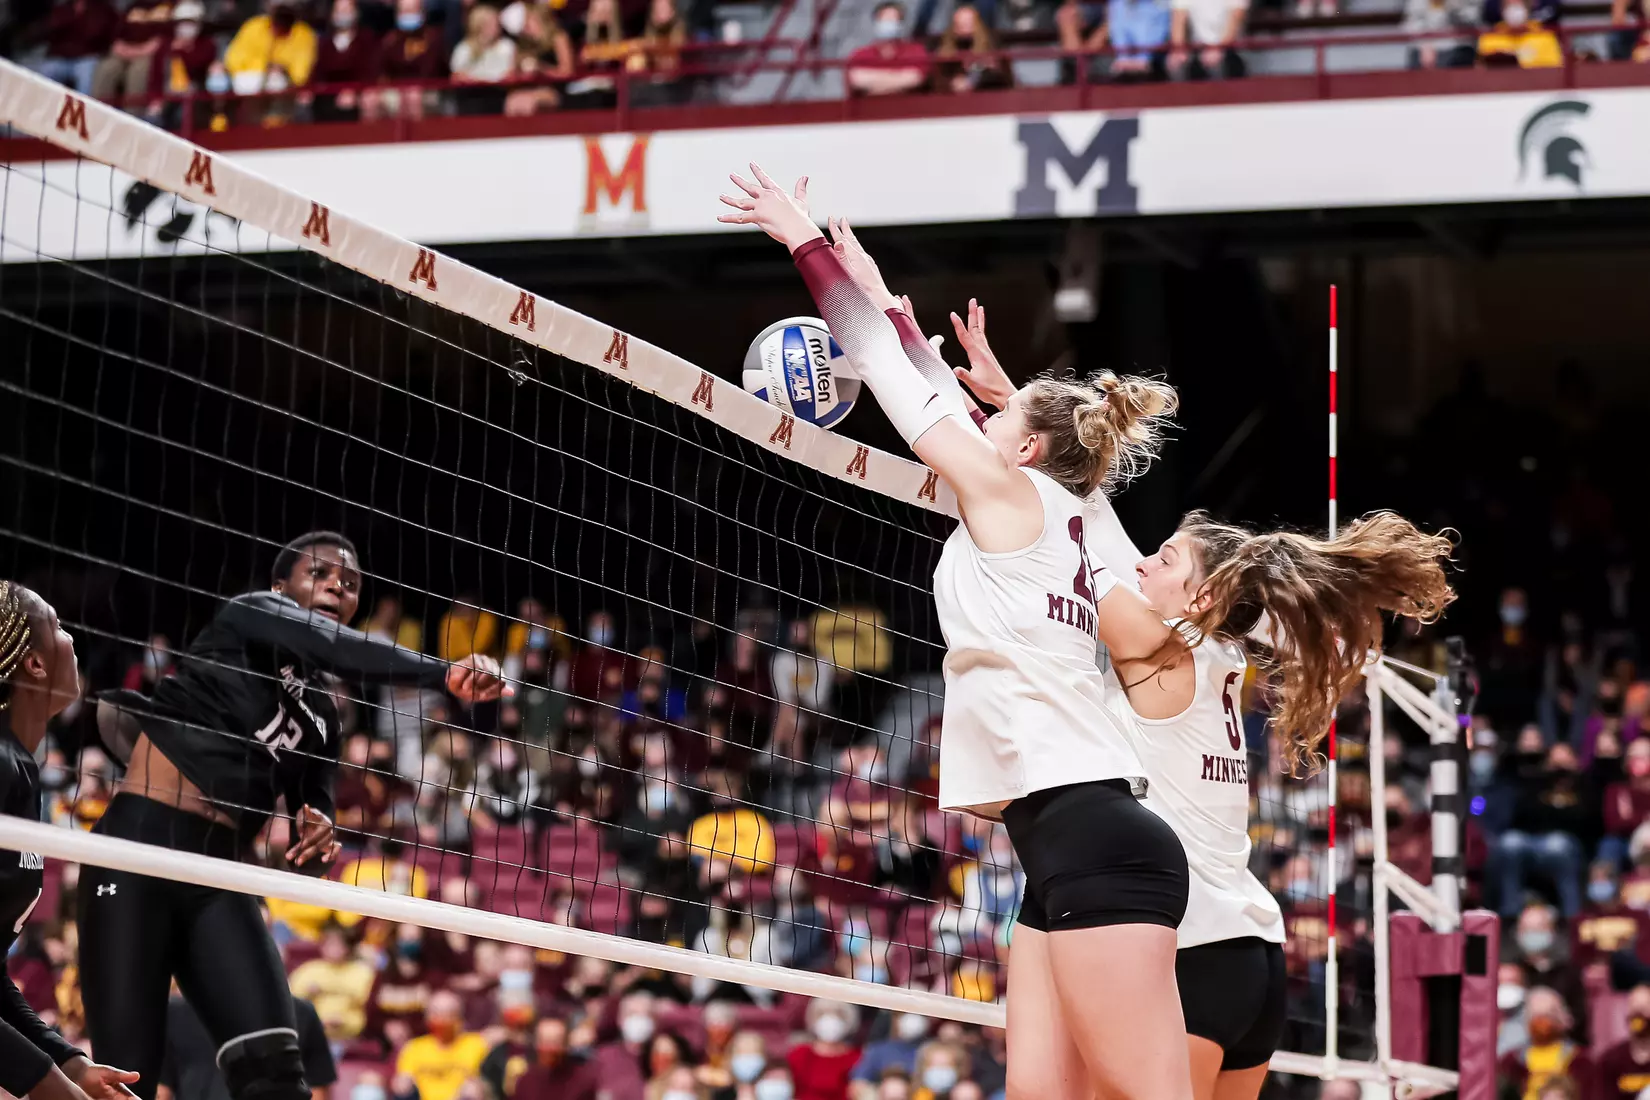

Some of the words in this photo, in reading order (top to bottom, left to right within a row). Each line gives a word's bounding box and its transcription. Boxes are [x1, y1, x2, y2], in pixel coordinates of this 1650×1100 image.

[56, 94, 89, 141] M
[184, 150, 217, 197] M
[581, 133, 649, 215] M
[1014, 114, 1139, 217] M
[301, 203, 331, 248] M
[408, 249, 438, 292] M
[508, 291, 536, 333] M
[602, 331, 629, 369] M
[808, 338, 831, 402] molten
[691, 373, 715, 411] M
[783, 348, 812, 402] NCAA
[768, 412, 795, 449] M
[846, 445, 870, 481] M
[916, 467, 939, 504] M
[254, 701, 303, 763] 12
[1221, 671, 1241, 751] 5
